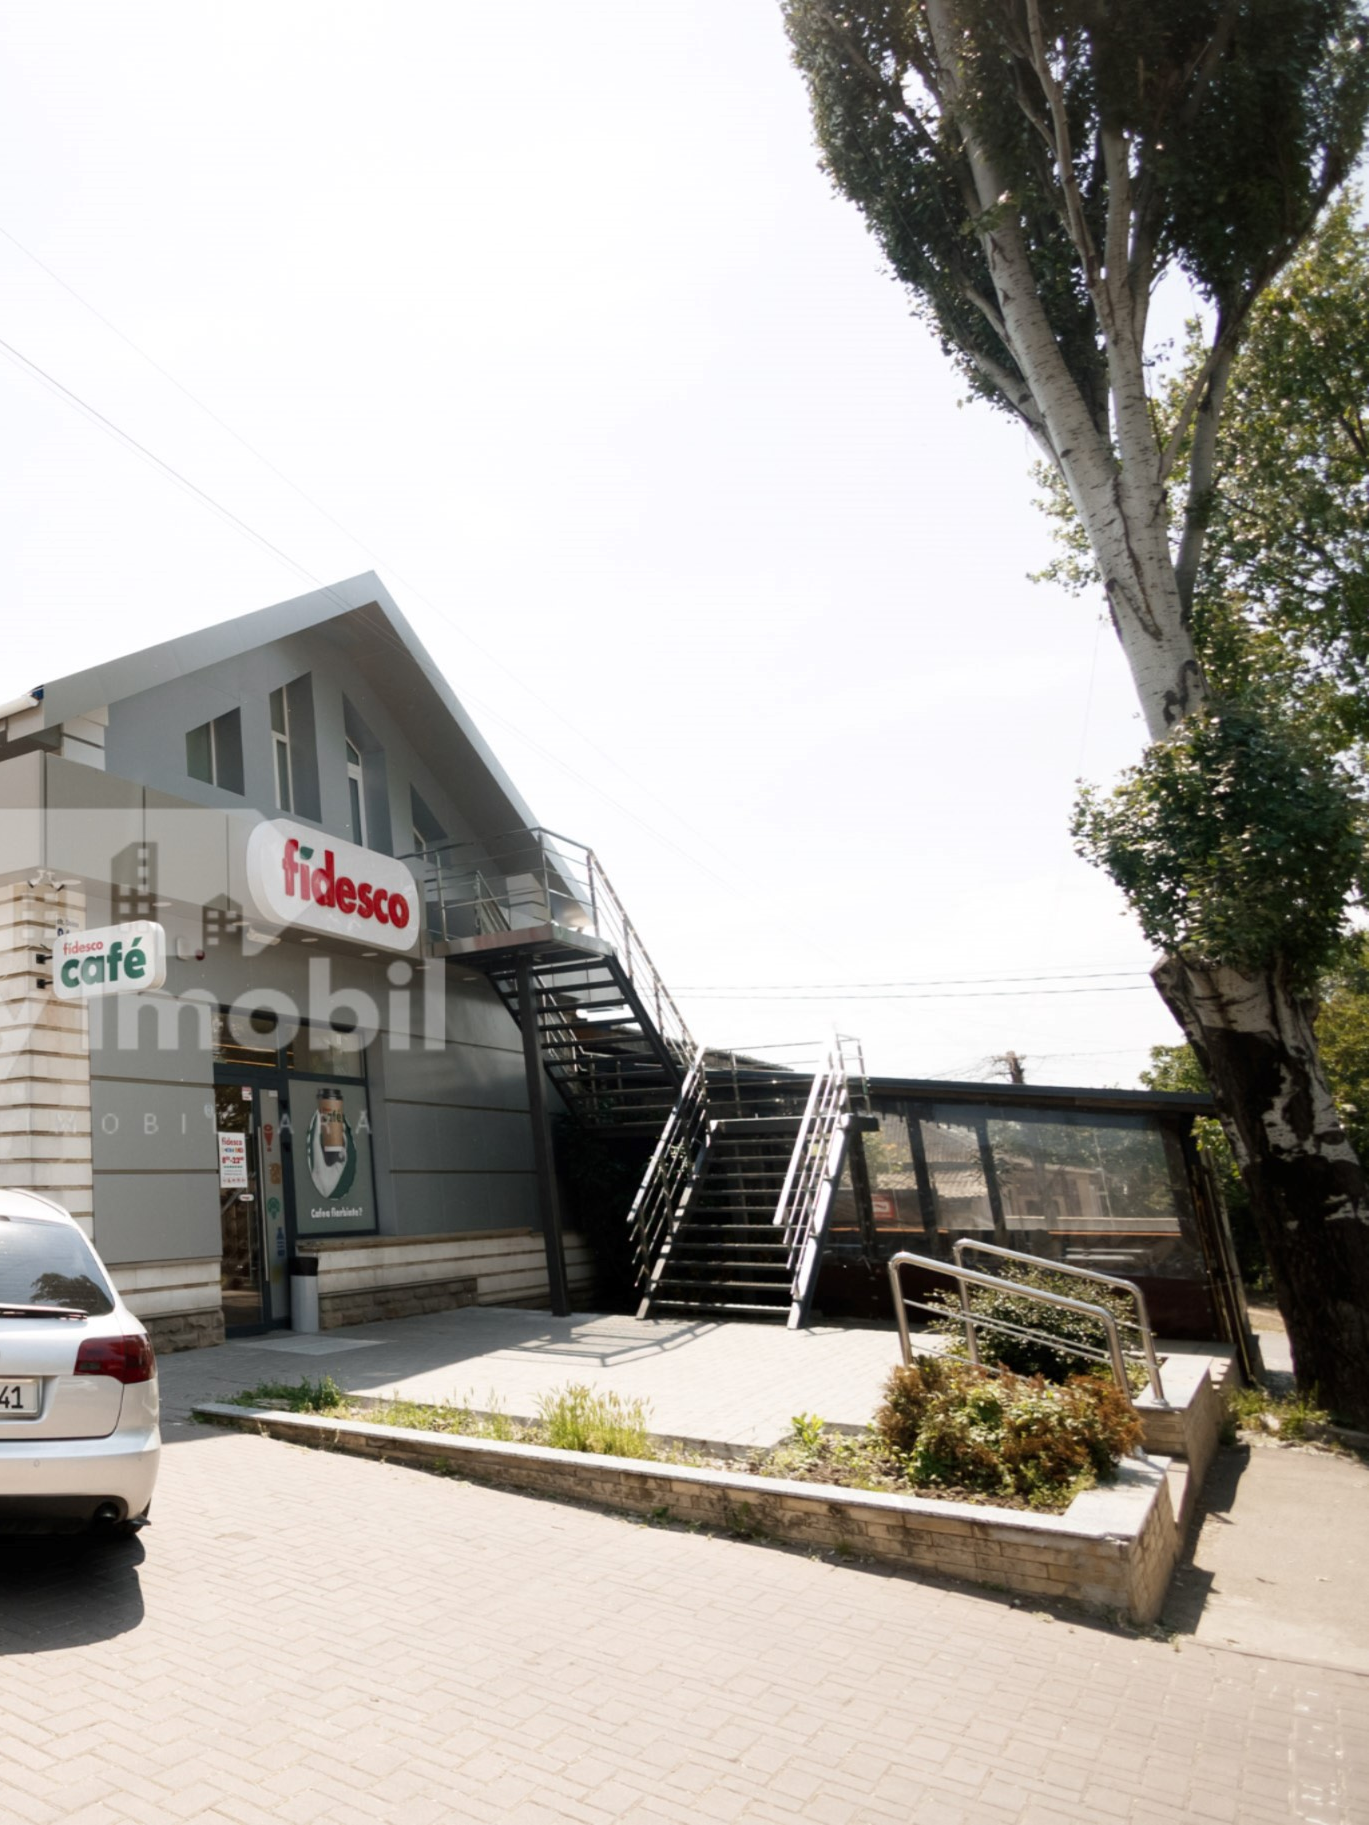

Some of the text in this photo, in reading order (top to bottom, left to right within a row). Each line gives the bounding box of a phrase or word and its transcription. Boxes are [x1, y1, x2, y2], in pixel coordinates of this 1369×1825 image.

[282, 838, 409, 929] fidesco
[60, 936, 147, 989] café
[63, 941, 104, 955] fidesco
